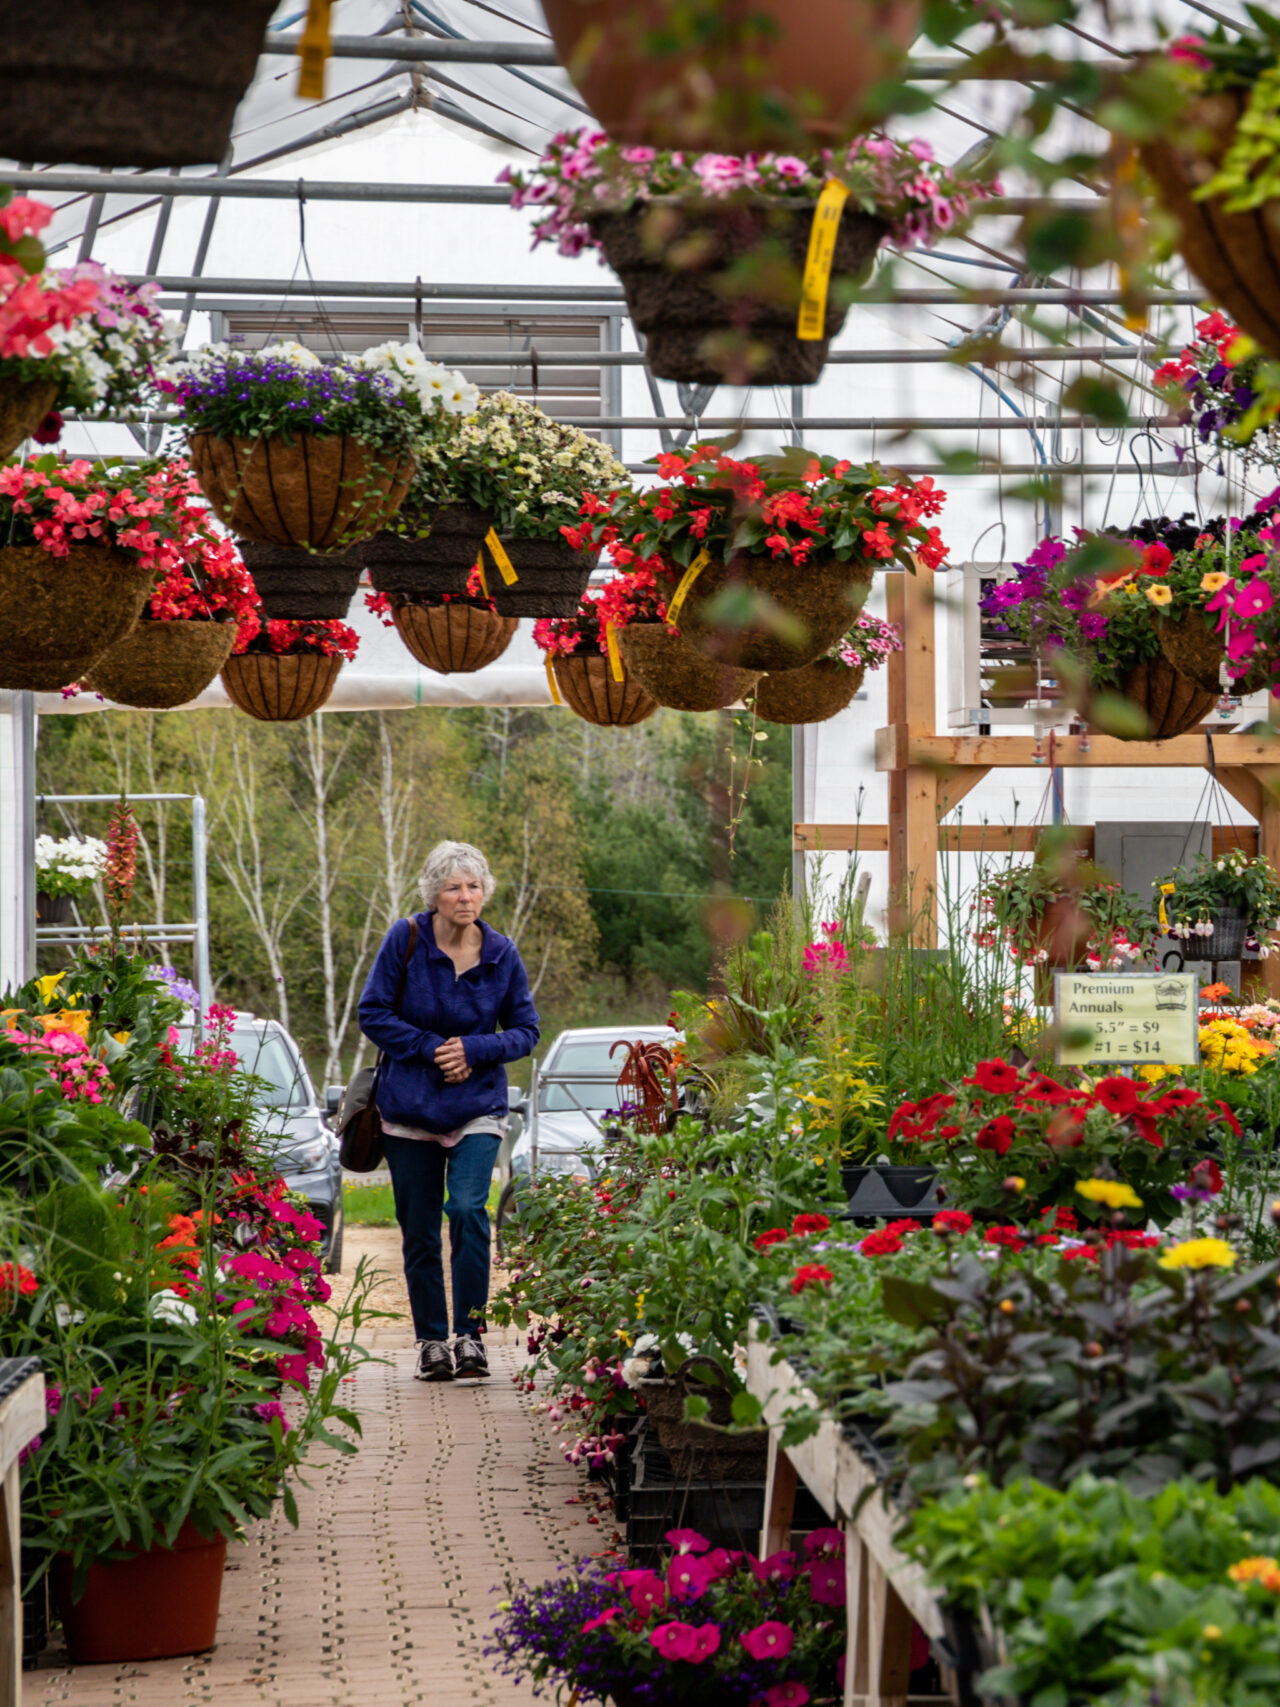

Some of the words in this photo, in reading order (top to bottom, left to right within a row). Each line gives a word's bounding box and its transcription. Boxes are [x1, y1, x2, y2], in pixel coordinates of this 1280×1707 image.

[1073, 982, 1134, 995] Premium
[1069, 1000, 1124, 1014] Annuals
[1142, 1020, 1160, 1034] $9
[1094, 1041, 1111, 1053] #1
[1132, 1039, 1161, 1055] $14
